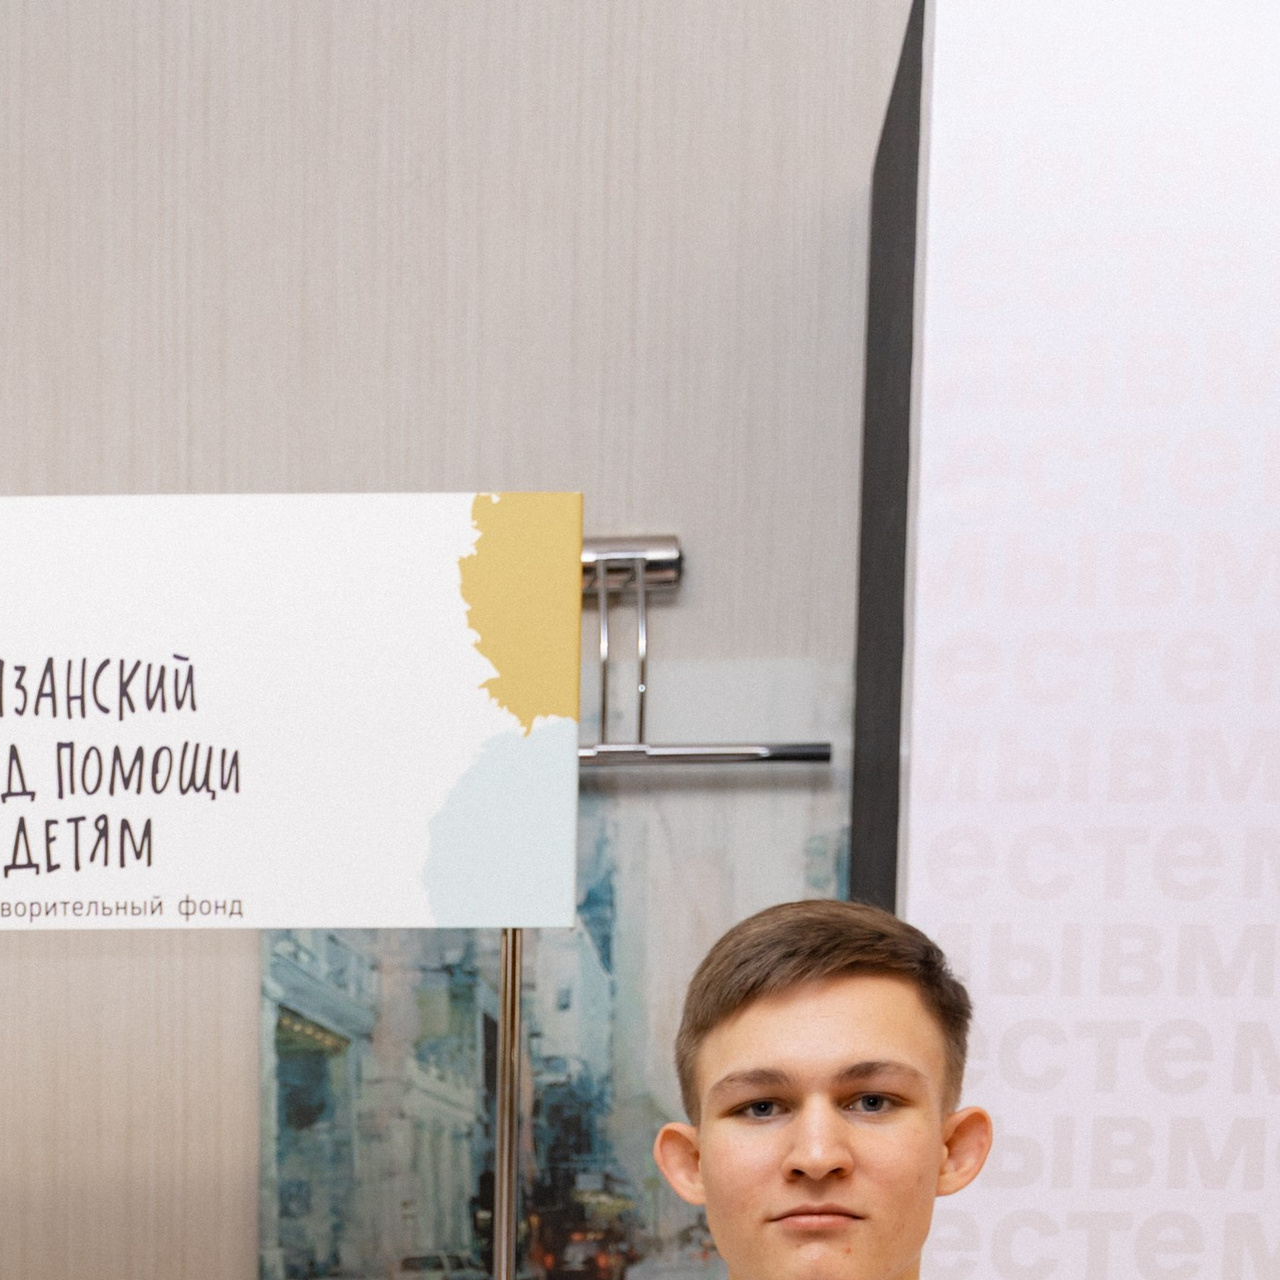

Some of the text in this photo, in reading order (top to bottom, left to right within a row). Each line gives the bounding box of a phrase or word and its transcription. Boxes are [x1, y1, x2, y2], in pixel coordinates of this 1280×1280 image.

[56, 740, 240, 801] ПОМОЩИ
[3, 814, 152, 878] ДЕТЯМ
[177, 894, 244, 922] фонд
